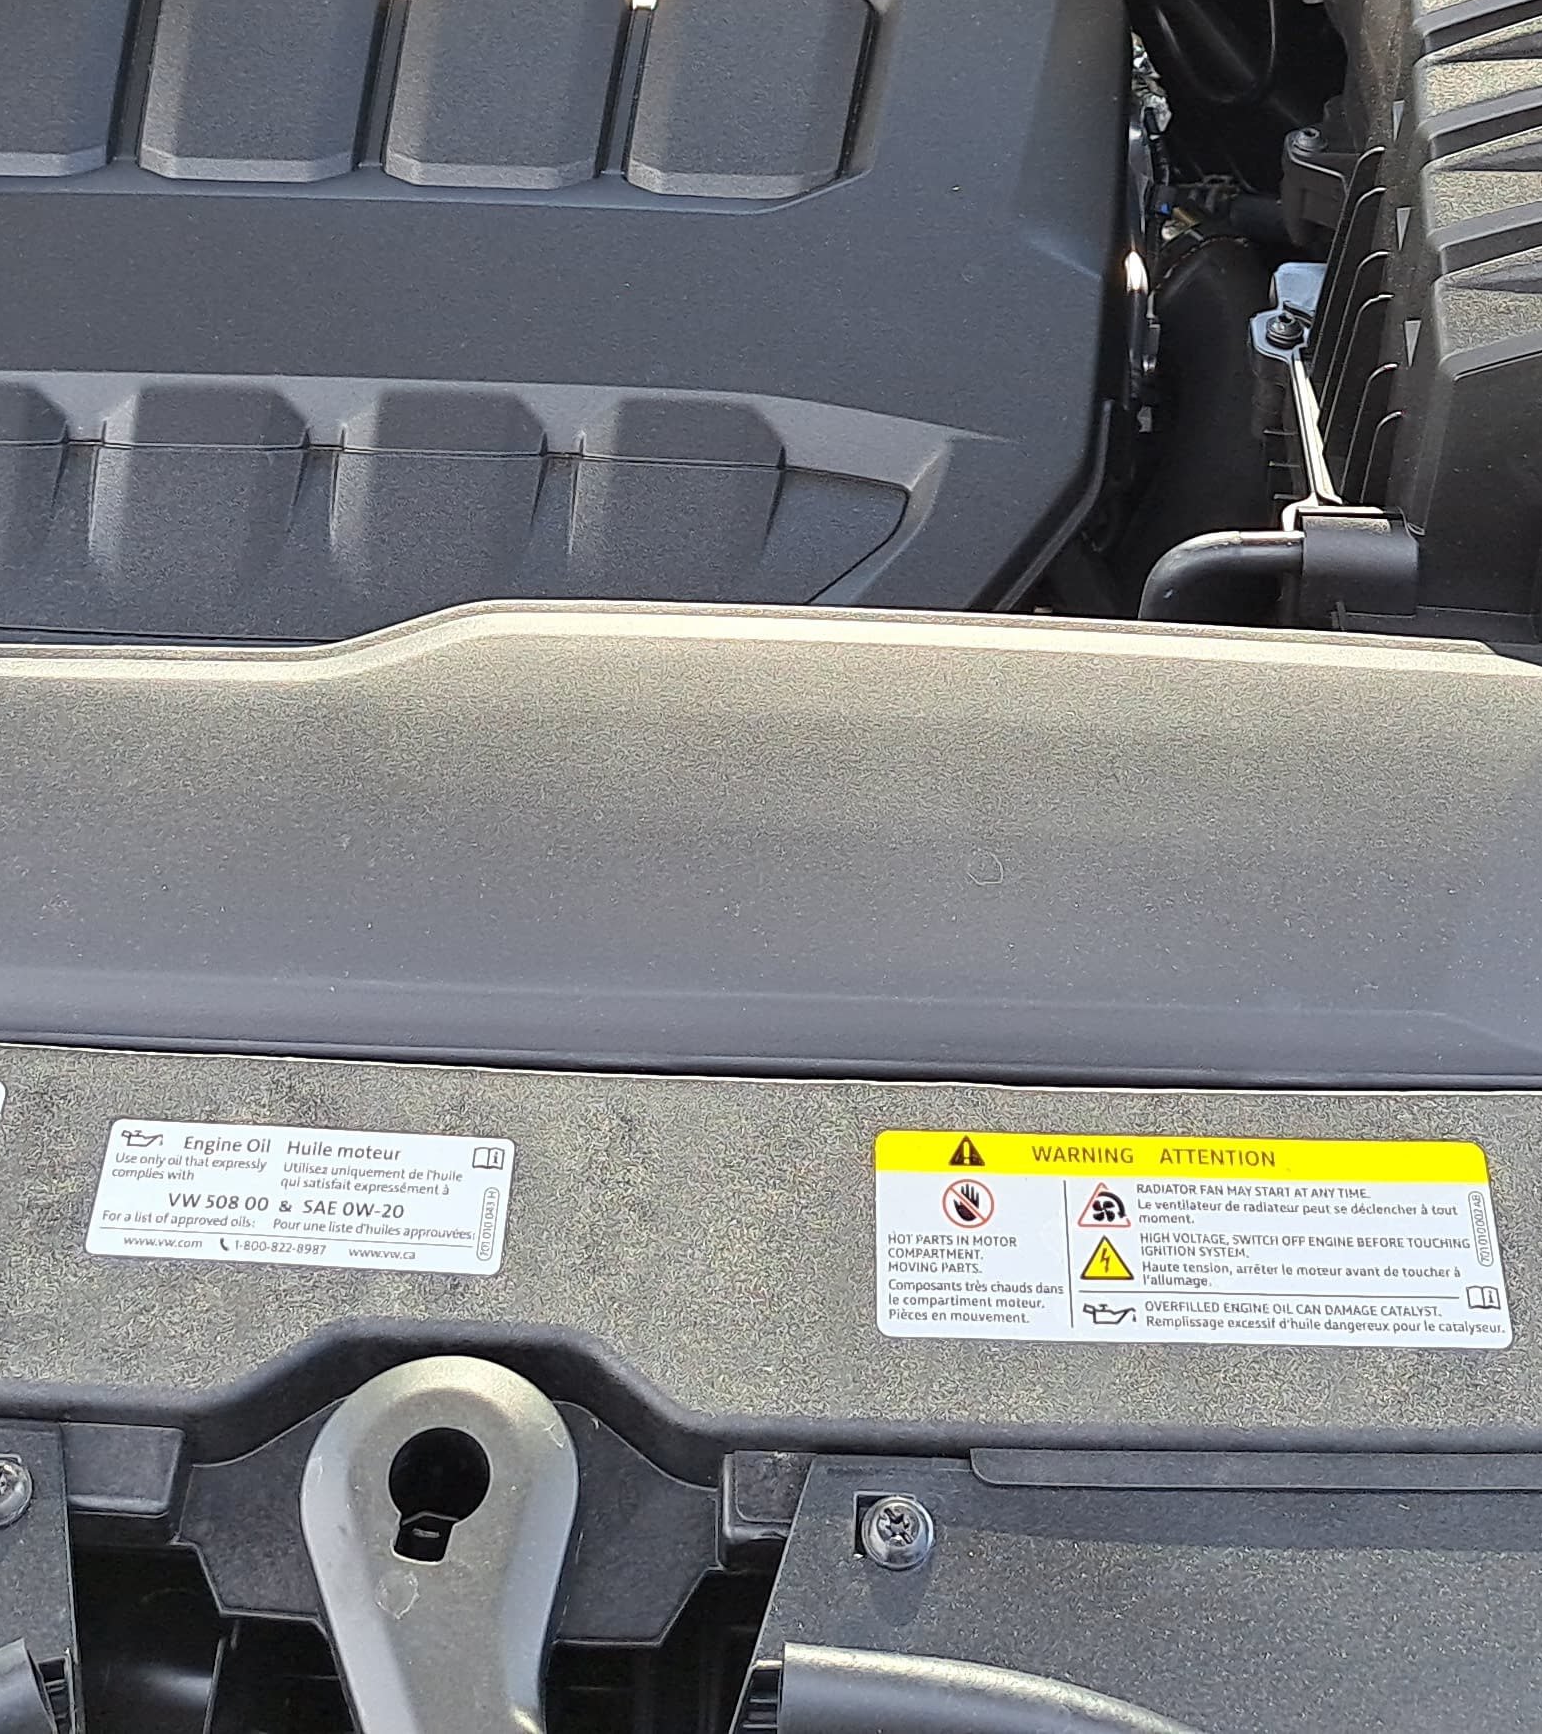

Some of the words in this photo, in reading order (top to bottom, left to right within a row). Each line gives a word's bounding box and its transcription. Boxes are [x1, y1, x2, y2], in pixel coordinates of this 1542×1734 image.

[183, 1135, 242, 1155] Engine
[246, 1137, 271, 1153] Oil
[286, 1140, 332, 1157] Huile
[336, 1144, 401, 1160] moteur
[114, 1151, 137, 1164] Use
[139, 1153, 166, 1168] only
[166, 1154, 183, 1165] oil
[184, 1154, 209, 1167] that
[211, 1157, 267, 1173] expressly
[1031, 1145, 1133, 1164] WARNING
[1159, 1147, 1275, 1167] ATTENTION
[111, 1167, 164, 1181] complies
[166, 1168, 194, 1180] with
[283, 1161, 328, 1175] Utilisez
[330, 1165, 405, 1180] uniquement
[407, 1168, 423, 1180] de
[425, 1169, 463, 1182] l'huile
[279, 1176, 300, 1190] qui
[302, 1177, 351, 1191] satisfait
[353, 1181, 439, 1195] expressément
[1135, 1183, 1197, 1194] RADIATOR
[1199, 1184, 1224, 1195] FAN
[1226, 1184, 1252, 1197] MAY
[1254, 1185, 1289, 1197] START
[1293, 1187, 1308, 1197] AT
[1310, 1187, 1335, 1198] ANY
[1336, 1187, 1371, 1199] TIME.
[168, 1192, 201, 1208] VW
[204, 1194, 239, 1209] 508
[244, 1195, 269, 1211] 00
[278, 1199, 292, 1212] &
[302, 1199, 337, 1215] SAE
[341, 1201, 404, 1219] 0W-20
[1136, 1198, 1152, 1210] Le
[1154, 1198, 1221, 1211] ventilateur
[1224, 1199, 1240, 1212] de
[1242, 1200, 1299, 1213] radiateur
[1302, 1204, 1330, 1215] peut
[1333, 1205, 1347, 1214] se
[1350, 1202, 1416, 1215] déclencher
[1430, 1204, 1458, 1215] tout
[101, 1209, 122, 1221] For
[123, 1213, 131, 1222] a
[133, 1211, 152, 1223] list
[154, 1211, 169, 1223] of
[169, 1214, 228, 1228] approved
[229, 1215, 255, 1227] oils:
[272, 1217, 301, 1230] Pour
[302, 1222, 326, 1232] une
[327, 1220, 353, 1233] liste
[354, 1222, 401, 1236] d'huiles
[1138, 1213, 1194, 1224] moment.
[123, 1236, 203, 1248] www.vw.com
[234, 1239, 327, 1255] 1-800-822-8987
[887, 1232, 913, 1244] HOT
[915, 1233, 953, 1245] PARTS
[956, 1234, 969, 1246] IN
[972, 1234, 1017, 1247] MOTOR
[1139, 1231, 1170, 1244] HIGH
[1172, 1232, 1229, 1246] VOLTAGE,
[1231, 1233, 1278, 1246] SWITCH
[1281, 1235, 1305, 1246] OFF
[1307, 1235, 1354, 1247] ENGINE
[1356, 1236, 1404, 1248] BEFORE
[1405, 1236, 1470, 1249] TOUCHING
[348, 1248, 416, 1260] www.vw.ca
[887, 1247, 983, 1259] COMPARTMENT.
[1140, 1245, 1195, 1256] IGNITION
[1198, 1245, 1249, 1258] SYSTEM.
[887, 1260, 938, 1273] MOVING
[940, 1261, 982, 1274] PARTS.
[1141, 1260, 1180, 1276] Haute
[1182, 1261, 1232, 1276] tension,
[1235, 1263, 1278, 1275] arrêter
[1280, 1263, 1293, 1275] le
[1296, 1266, 1342, 1276] moteur
[1344, 1266, 1380, 1277] avant
[1383, 1265, 1399, 1277] de
[1401, 1266, 1450, 1278] toucher
[887, 1278, 962, 1293] Composants
[964, 1279, 987, 1292] très
[990, 1280, 1033, 1294] chauds
[1035, 1281, 1064, 1294] dans
[1142, 1273, 1211, 1289] l'allumage.
[888, 1292, 899, 1305] le
[902, 1294, 992, 1308] compartiment
[995, 1297, 1045, 1309] moteur.
[1144, 1300, 1220, 1313] OVERFILLED
[1222, 1301, 1269, 1314] ENGINE
[1272, 1302, 1294, 1314] OIL
[1295, 1303, 1321, 1315] CAN
[1324, 1303, 1378, 1316] DAMAGE
[1379, 1305, 1442, 1317] CATALYST.
[888, 1307, 928, 1321] Pièces
[930, 1311, 946, 1321] en
[949, 1311, 1029, 1323] mouvement.
[1145, 1314, 1224, 1330] Remplissage
[1226, 1316, 1275, 1329] excessif
[1278, 1317, 1321, 1330] d'huile
[1323, 1318, 1390, 1334] dangereux
[1392, 1322, 1421, 1334] pour
[1423, 1319, 1436, 1332] le
[1437, 1320, 1505, 1335] catalyseur.
